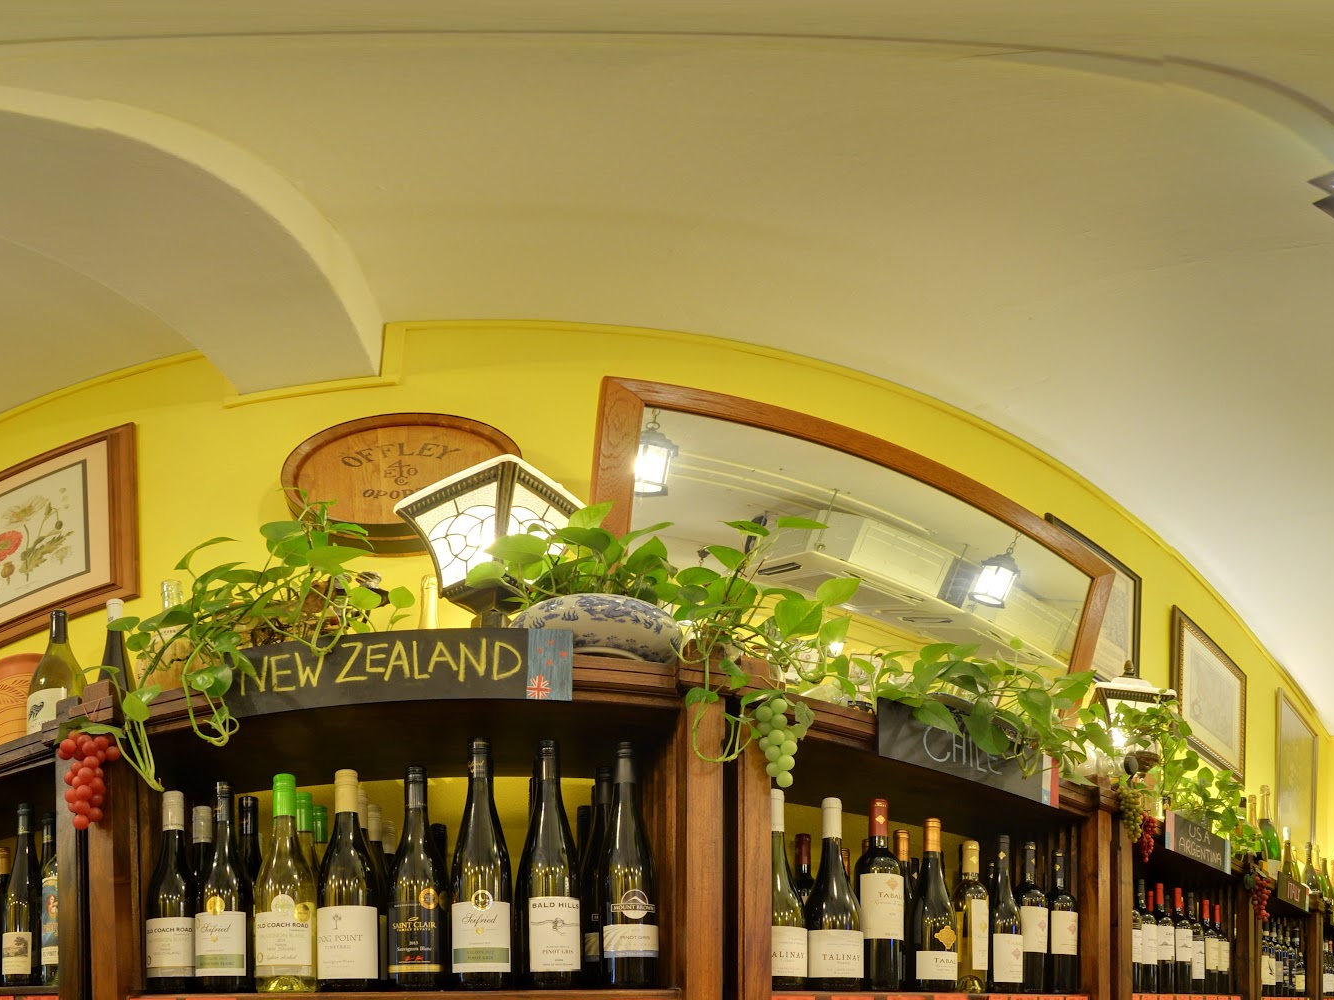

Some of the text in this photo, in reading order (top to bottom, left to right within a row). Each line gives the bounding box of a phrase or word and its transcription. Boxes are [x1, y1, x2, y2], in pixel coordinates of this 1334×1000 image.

[340, 442, 464, 469] OFFLEY
[239, 637, 523, 696] NEW ZEALAND
[1187, 822, 1212, 846] USA
[1177, 836, 1223, 867] ARGENTINA
[1287, 879, 1302, 901] ITALY
[392, 921, 437, 930] SAINT CLAIR
[461, 913, 498, 928] Seifried
[335, 934, 363, 942] POINT
[822, 953, 861, 962] TALINAY
